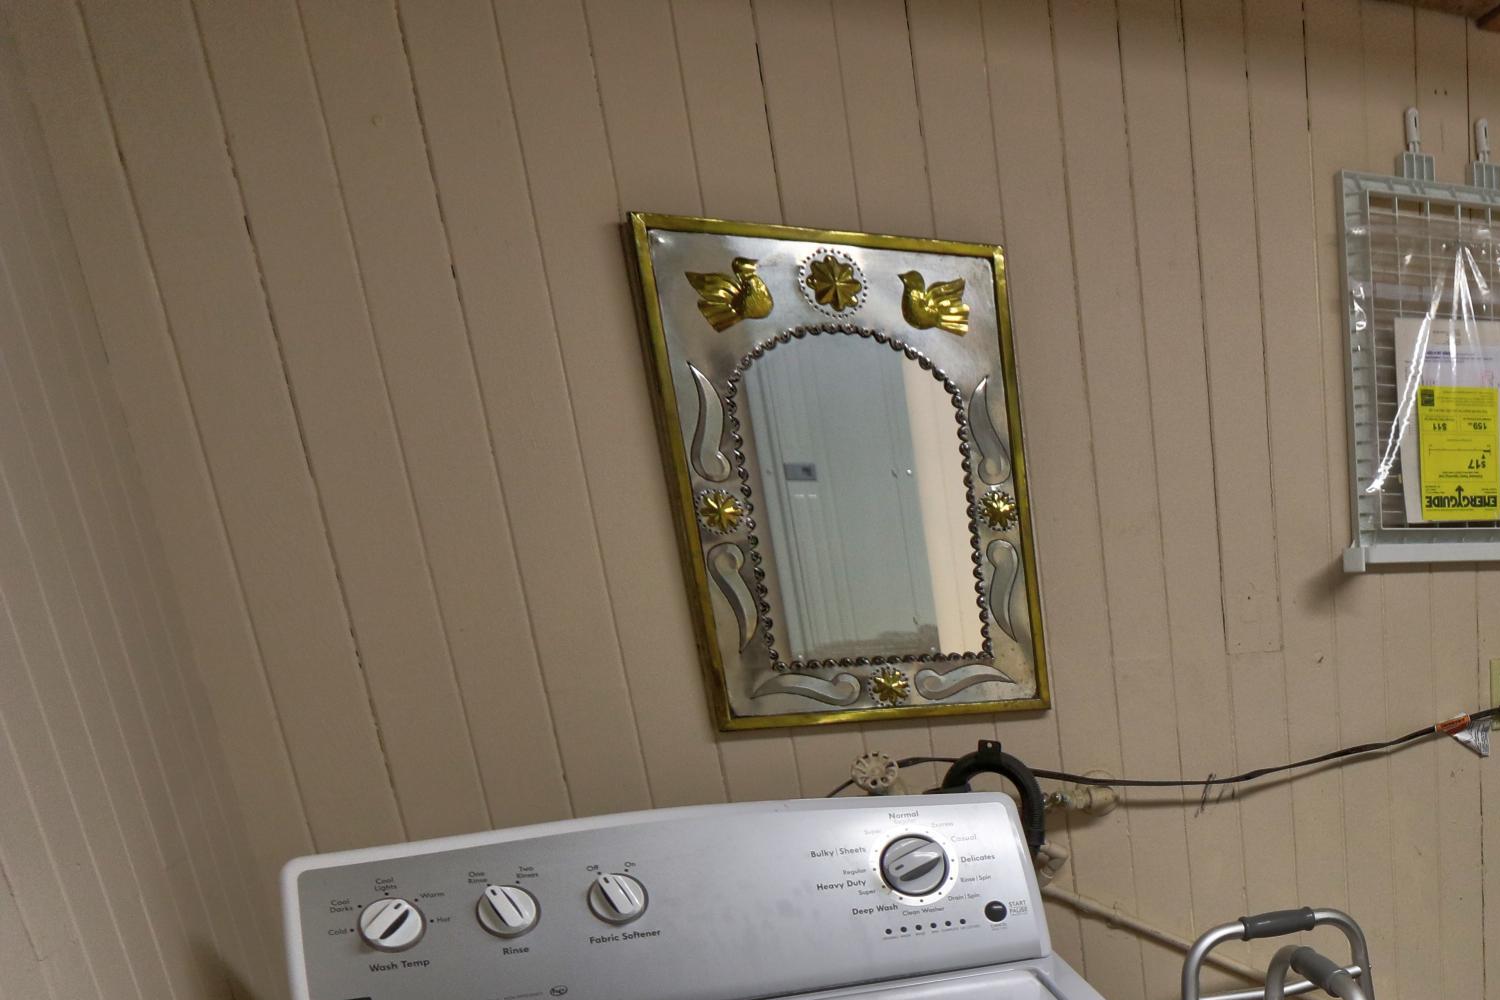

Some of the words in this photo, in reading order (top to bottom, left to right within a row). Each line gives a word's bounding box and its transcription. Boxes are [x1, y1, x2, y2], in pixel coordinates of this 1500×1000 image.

[1468, 459, 1486, 470] $17
[888, 810, 919, 819] Normal
[951, 834, 977, 842] Casual
[810, 849, 834, 858] Bulky
[840, 847, 867, 855] Sheets
[960, 854, 995, 863] Delicates
[816, 882, 844, 891] Heavy
[852, 907, 874, 915] Deep
[876, 904, 898, 912] Wash
[589, 935, 620, 945] Fabric
[622, 929, 661, 941] Softener
[502, 946, 530, 955] Rinse
[369, 961, 398, 972] Wash
[401, 959, 430, 969] Temp
